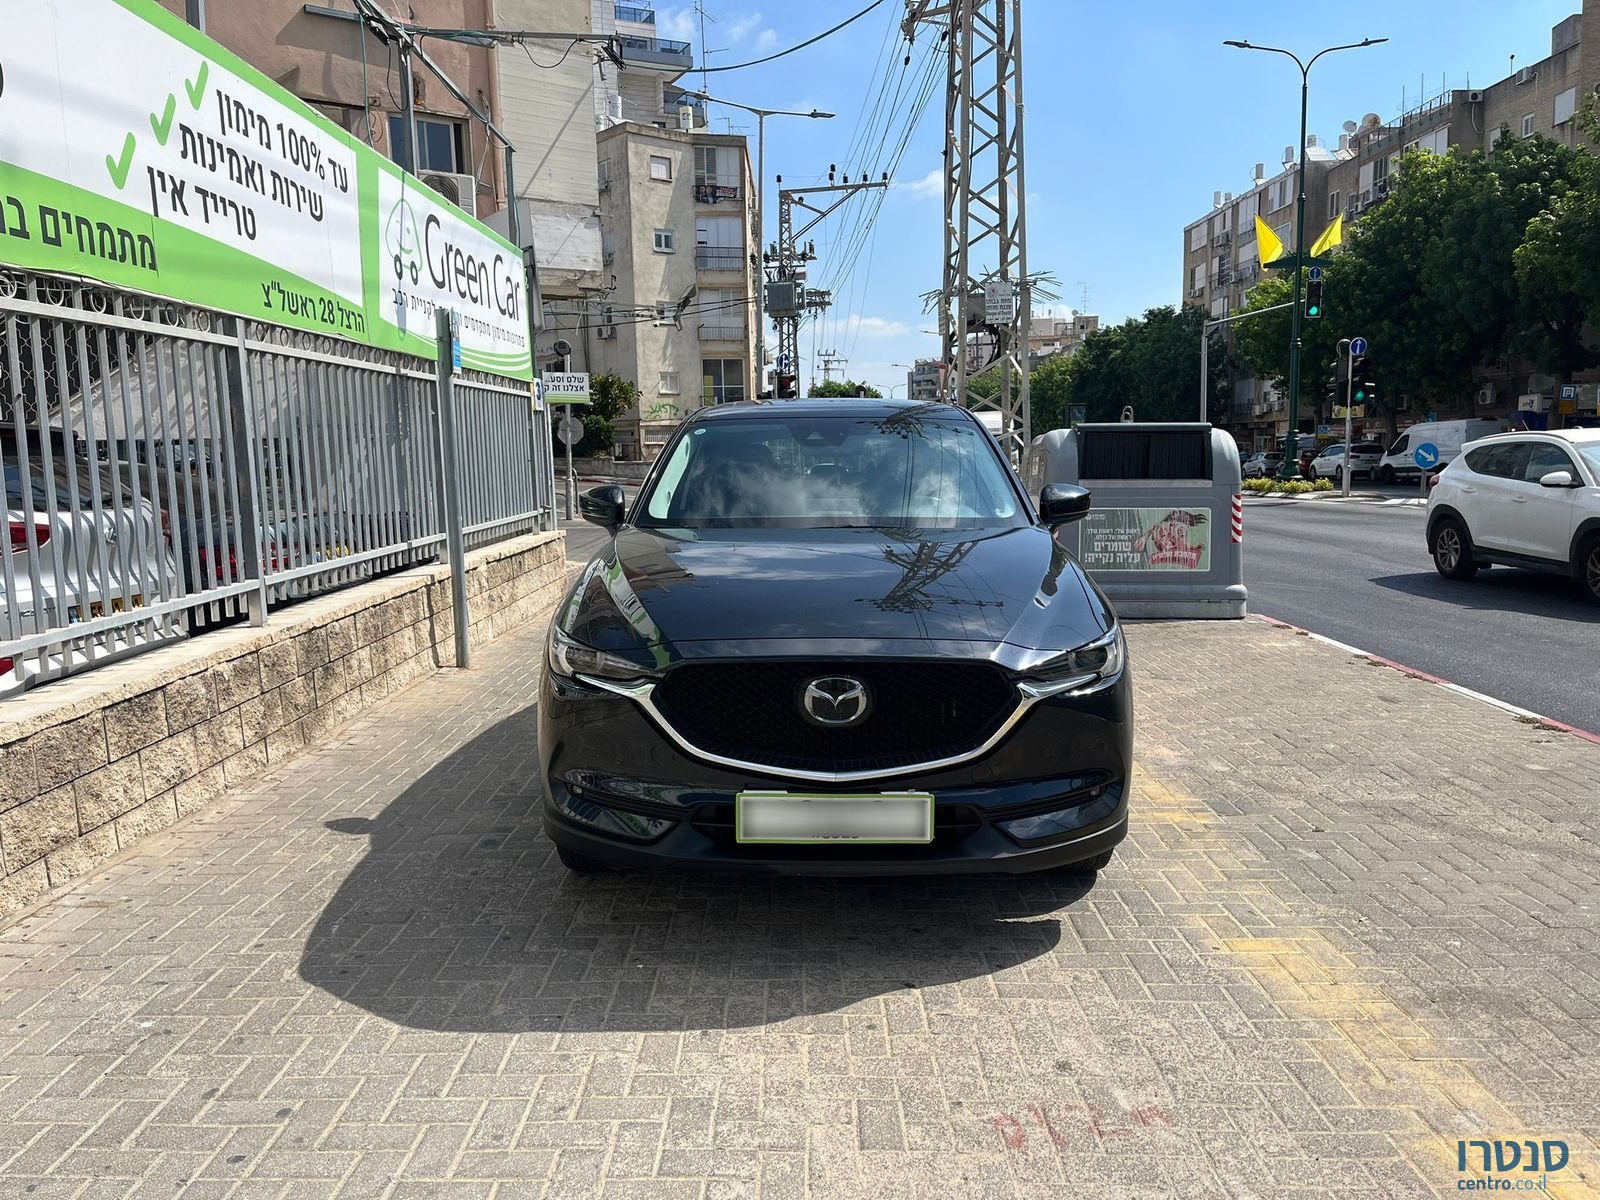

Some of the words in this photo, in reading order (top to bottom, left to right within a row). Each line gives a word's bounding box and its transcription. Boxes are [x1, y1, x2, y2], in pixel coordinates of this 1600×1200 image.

[215, 88, 273, 151] מימון
[178, 121, 266, 196] ואמינות
[276, 122, 325, 181] 100%
[146, 165, 190, 218] אין
[327, 157, 349, 194] עד
[194, 183, 257, 241] טרייד
[271, 168, 324, 222] שירות
[38, 204, 158, 272] מתמחים
[424, 213, 492, 310] Green
[493, 253, 520, 322] Car
[262, 279, 318, 319] ראשל"צ
[318, 298, 336, 325] 28
[391, 287, 409, 309] רכב
[336, 300, 366, 334] הרצל
[544, 384, 550, 393] ק
[552, 384, 561, 392] זה
[563, 384, 585, 392] אצלנו
[566, 375, 585, 384] שלם
[1093, 541, 1132, 551] שומרים
[1116, 552, 1141, 563] עליה
